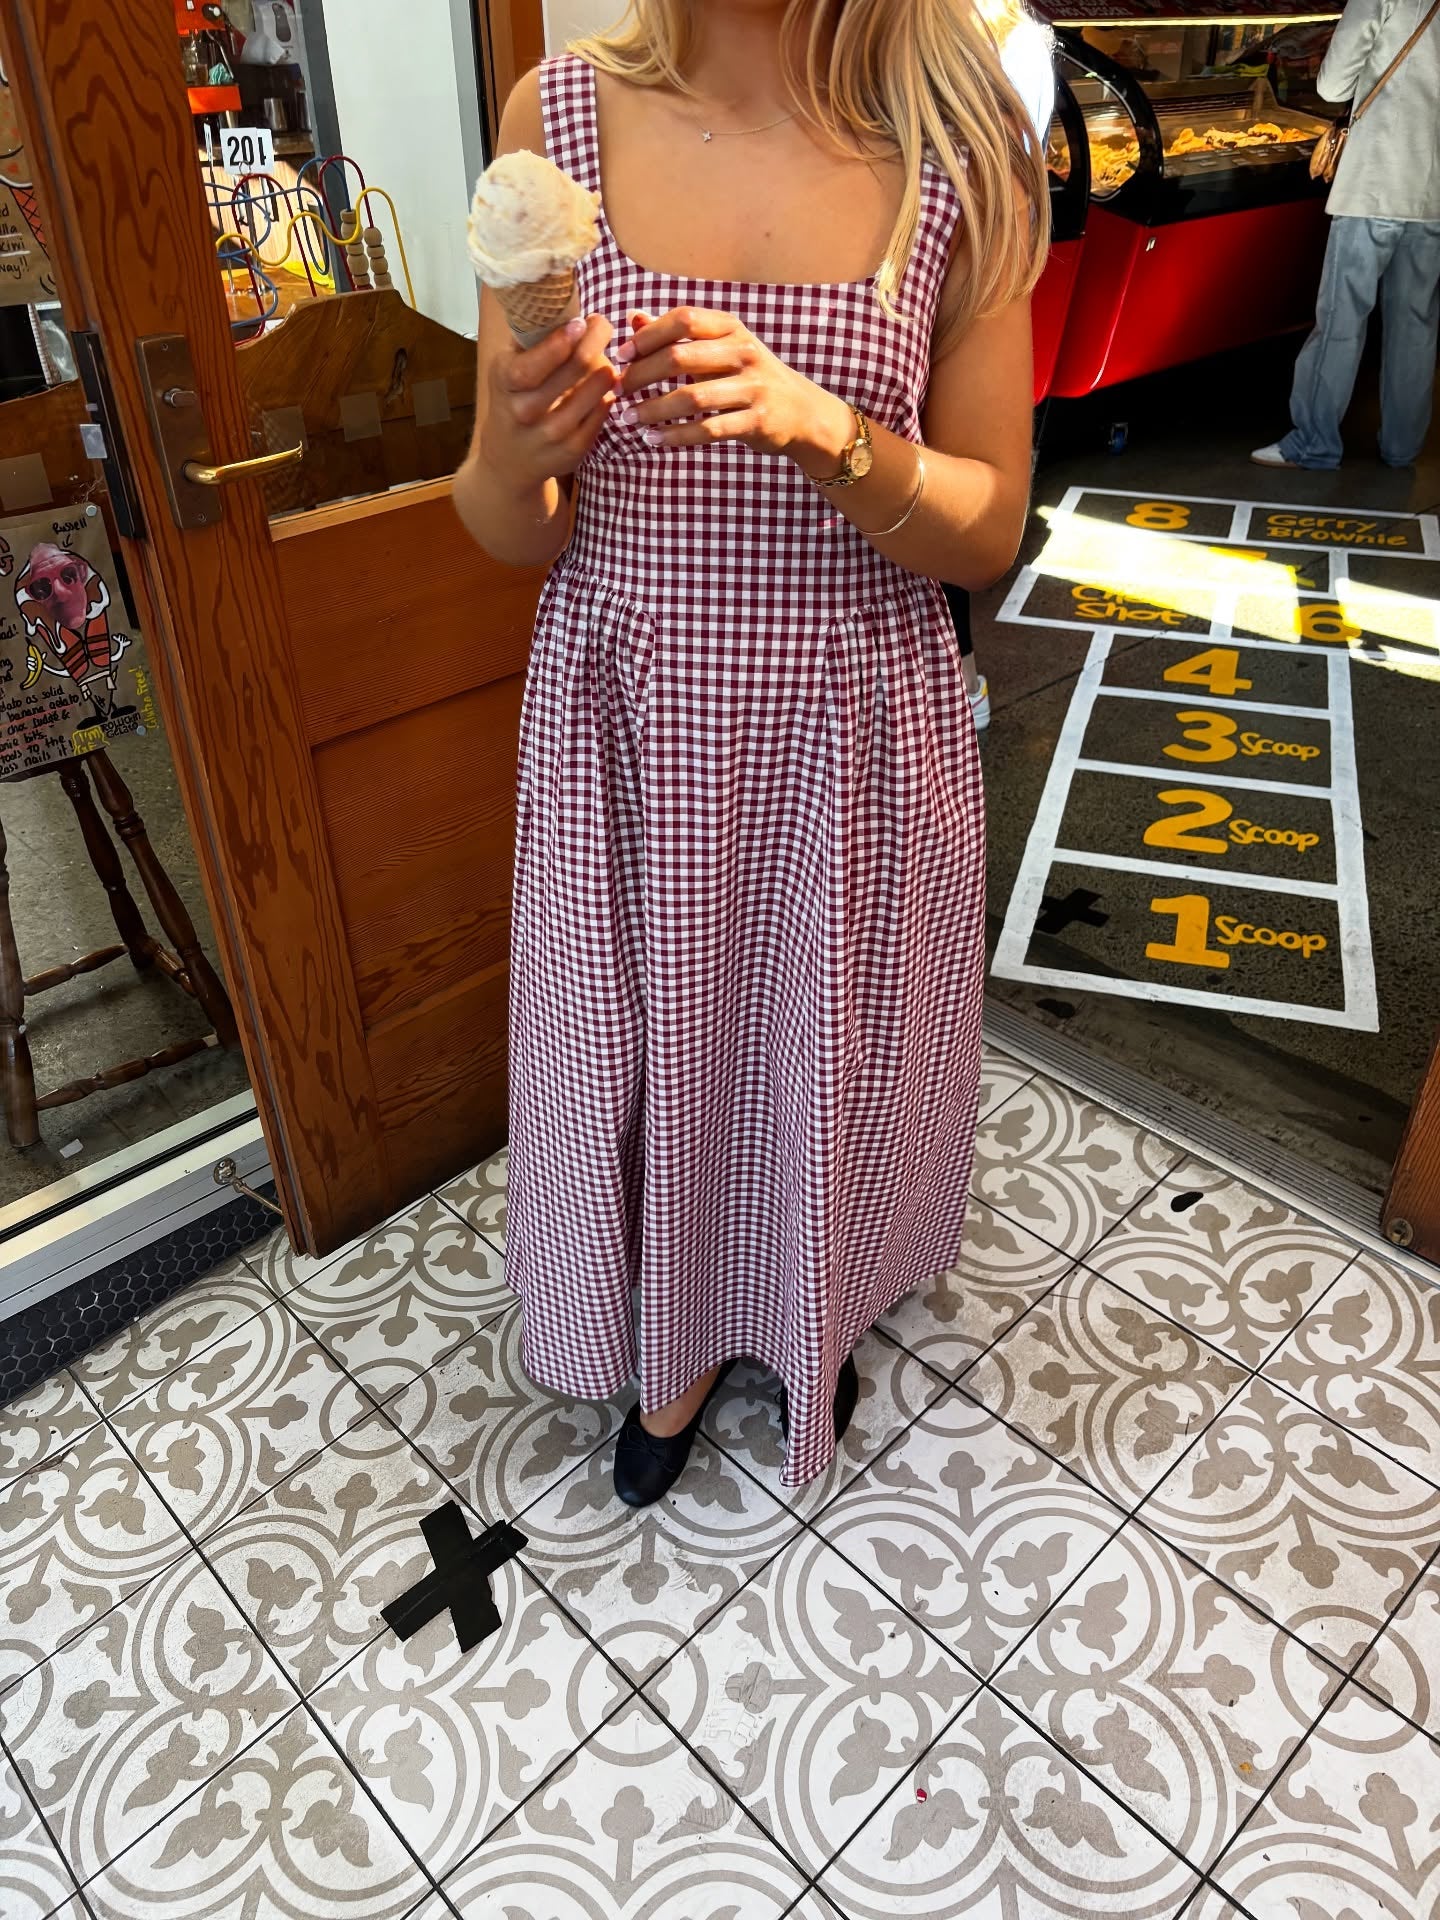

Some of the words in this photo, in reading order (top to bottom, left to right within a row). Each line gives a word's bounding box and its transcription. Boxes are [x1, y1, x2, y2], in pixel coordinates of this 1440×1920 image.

[52, 517, 87, 534] Russell
[1126, 502, 1191, 530] 8
[1266, 513, 1377, 534] Gerry
[1266, 526, 1408, 547] Brownie
[1074, 602, 1188, 626] Shot
[1292, 603, 1362, 643] 6
[1163, 648, 1252, 696] 4
[26, 695, 38, 704] as
[42, 685, 65, 699] solid
[7, 706, 46, 722] banana
[45, 735, 65, 748] the
[1162, 710, 1238, 763] 3
[1239, 732, 1321, 761] Scoop
[24, 751, 50, 766] nails
[1143, 788, 1233, 854] 2
[1228, 819, 1319, 853] Scoop
[1145, 894, 1230, 969] 1
[1214, 915, 1327, 959] Scoop
